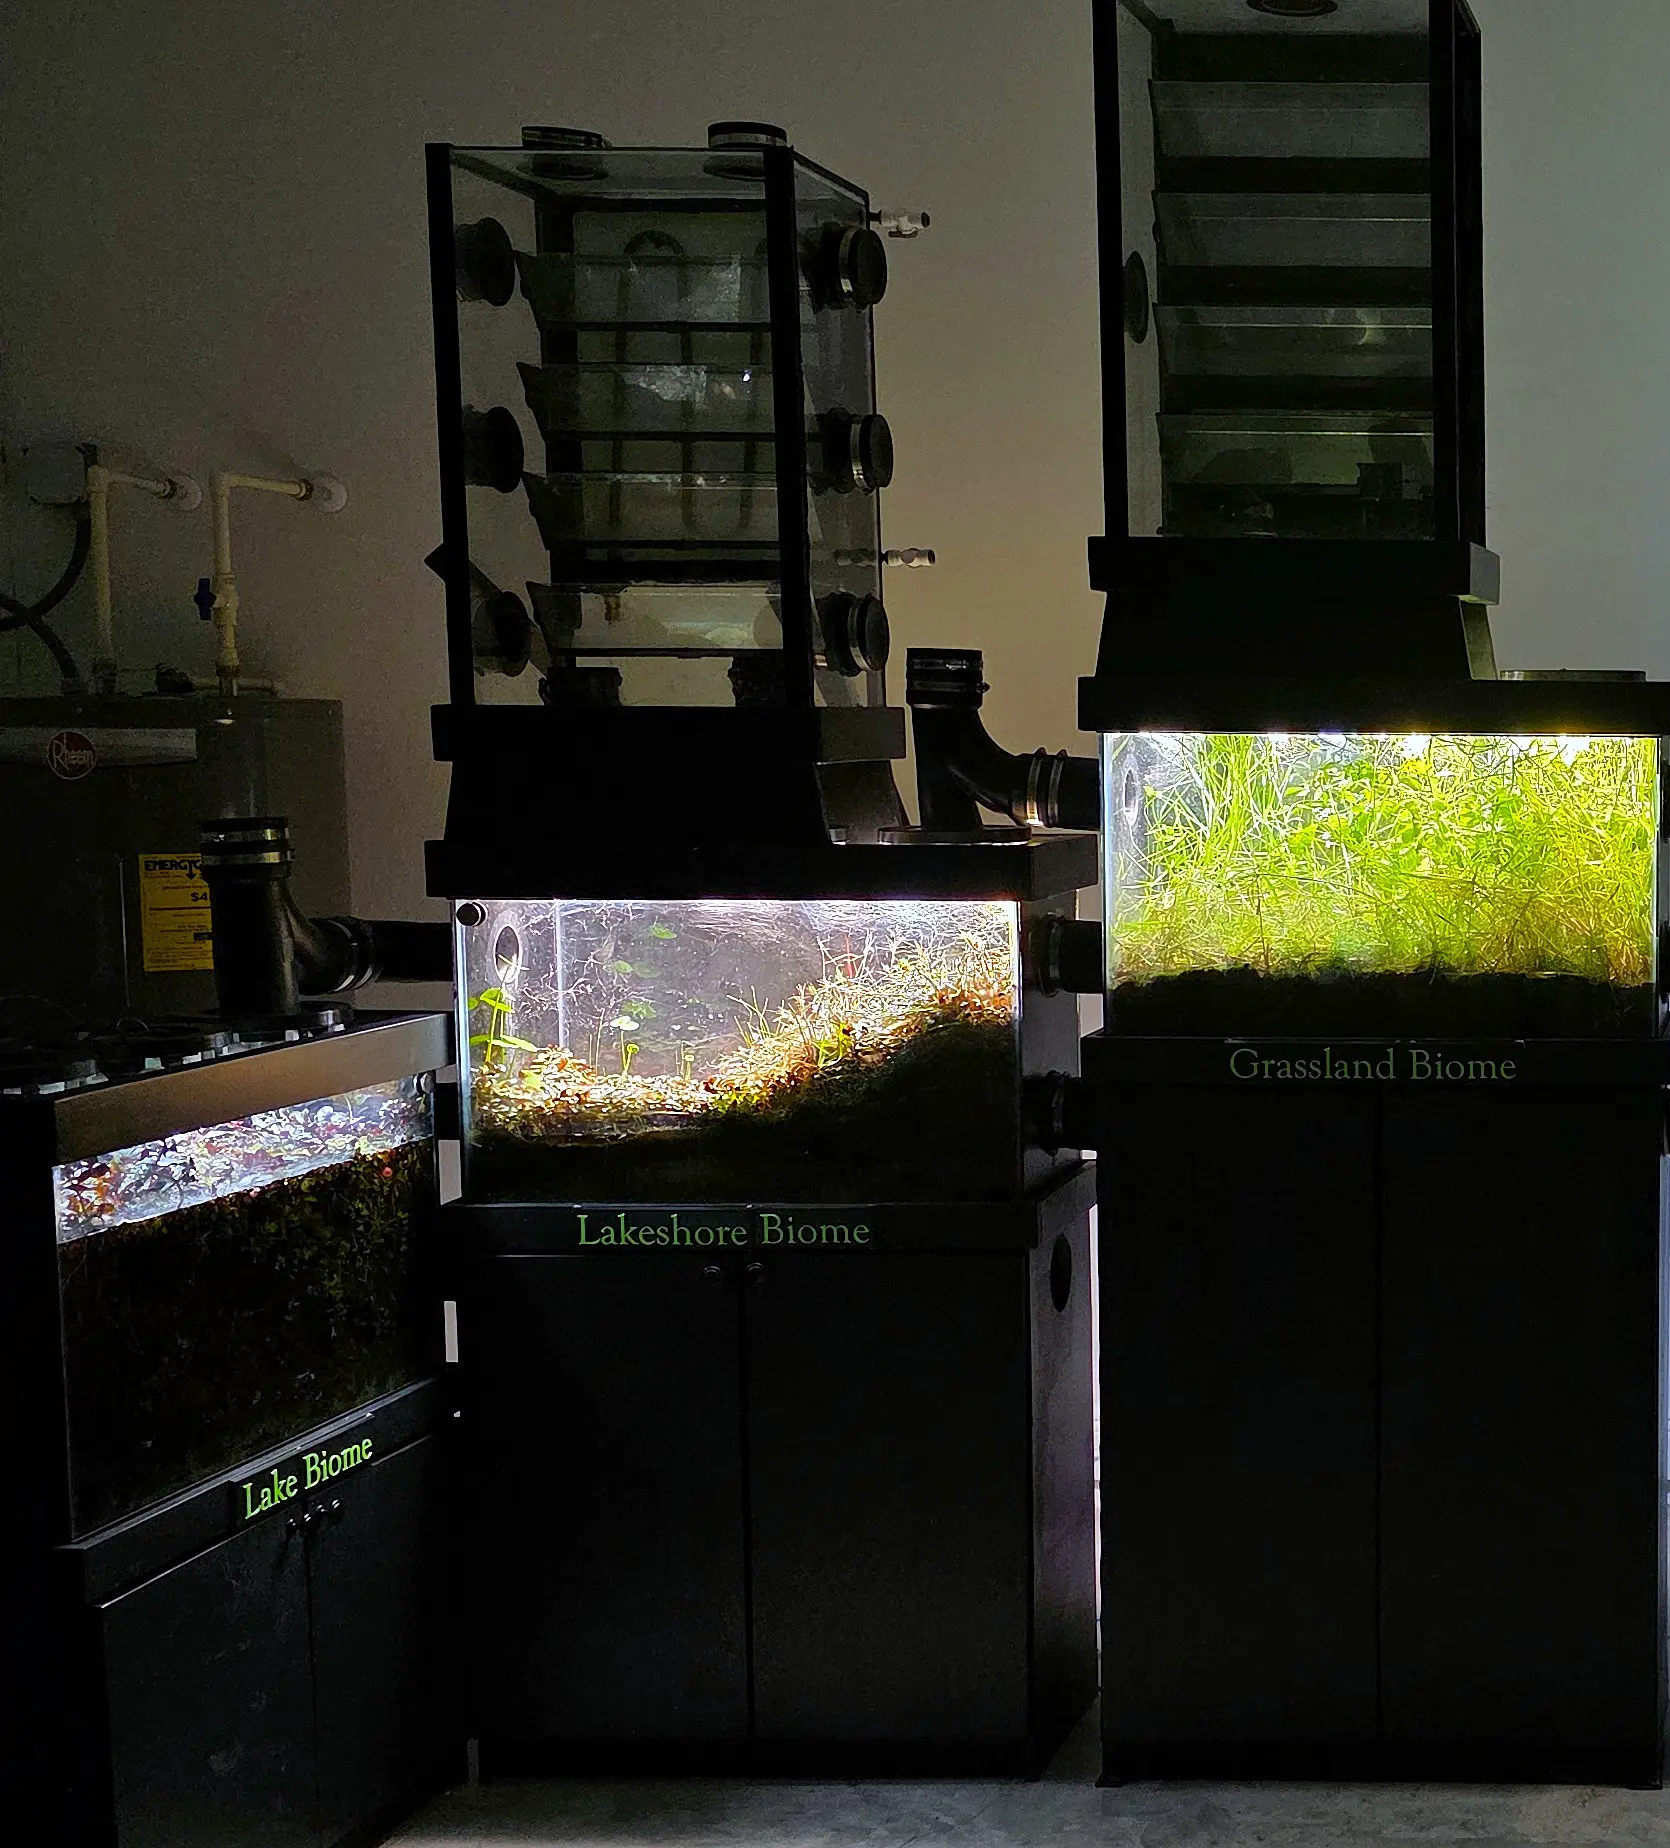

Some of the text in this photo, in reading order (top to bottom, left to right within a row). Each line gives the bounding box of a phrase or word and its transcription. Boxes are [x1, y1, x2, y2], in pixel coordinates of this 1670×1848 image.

[1229, 1047, 1517, 1080] Grassland Biome
[577, 1213, 870, 1246] Lakeshore Biome
[241, 1438, 373, 1520] Lake Biome
